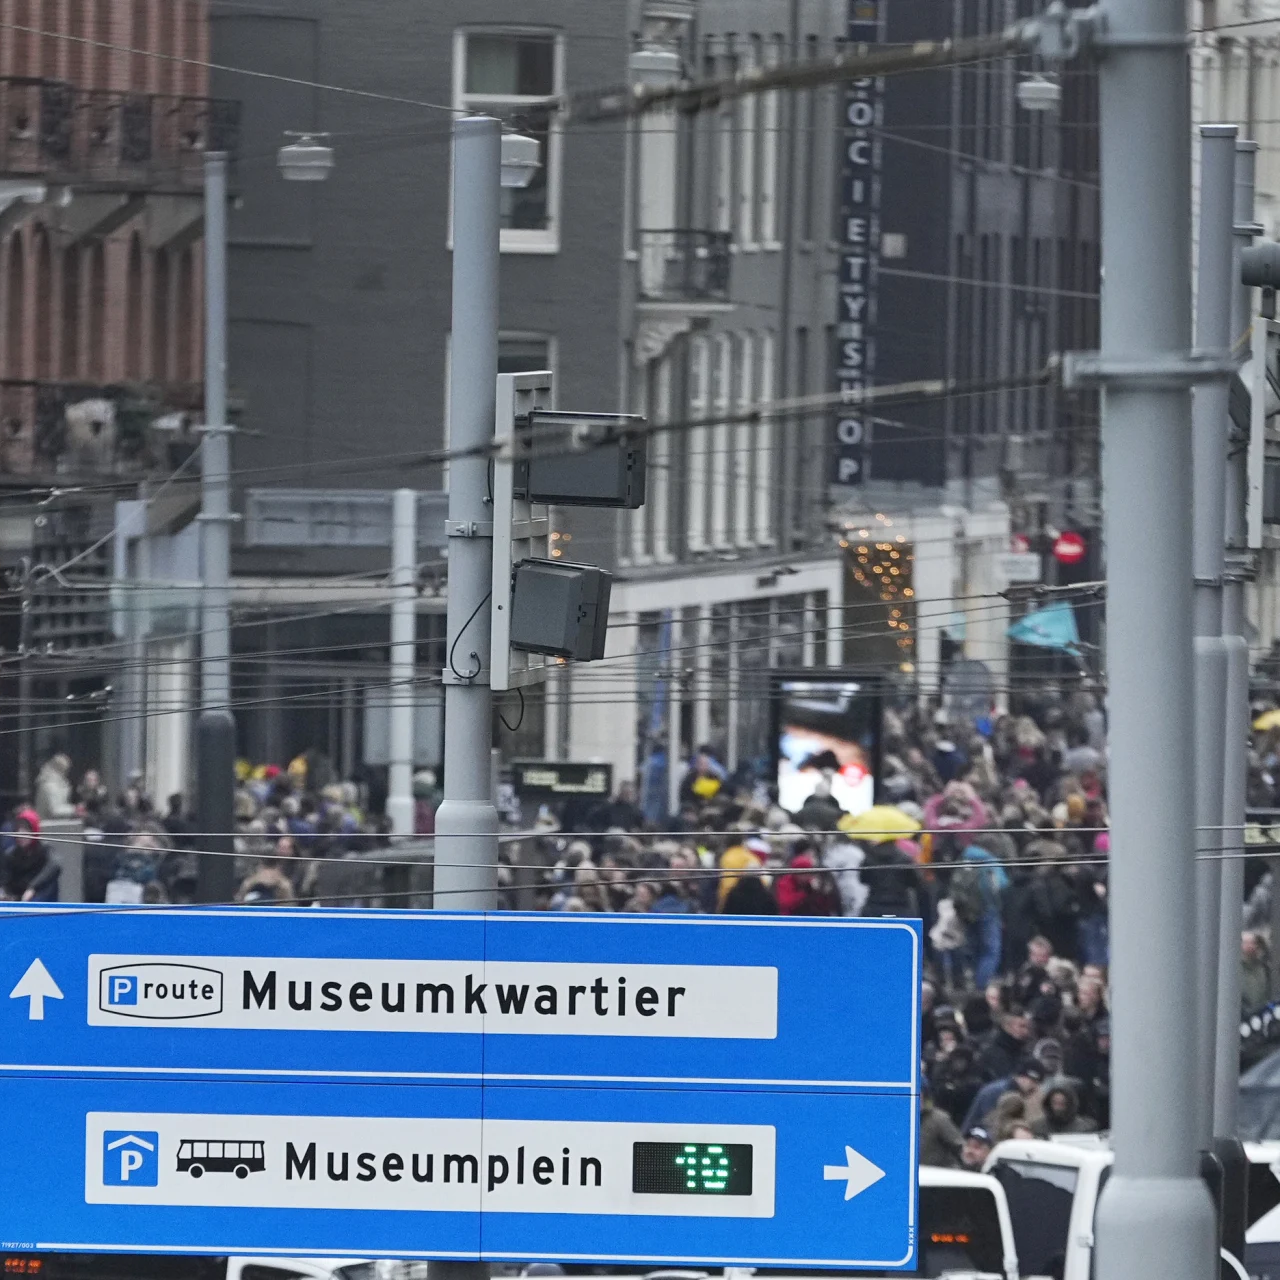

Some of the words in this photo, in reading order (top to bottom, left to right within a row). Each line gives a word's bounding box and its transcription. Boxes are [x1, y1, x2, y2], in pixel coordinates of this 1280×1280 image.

[143, 977, 215, 1002] route
[242, 968, 687, 1017] Museumkwartier
[285, 1141, 603, 1192] Museumplein
